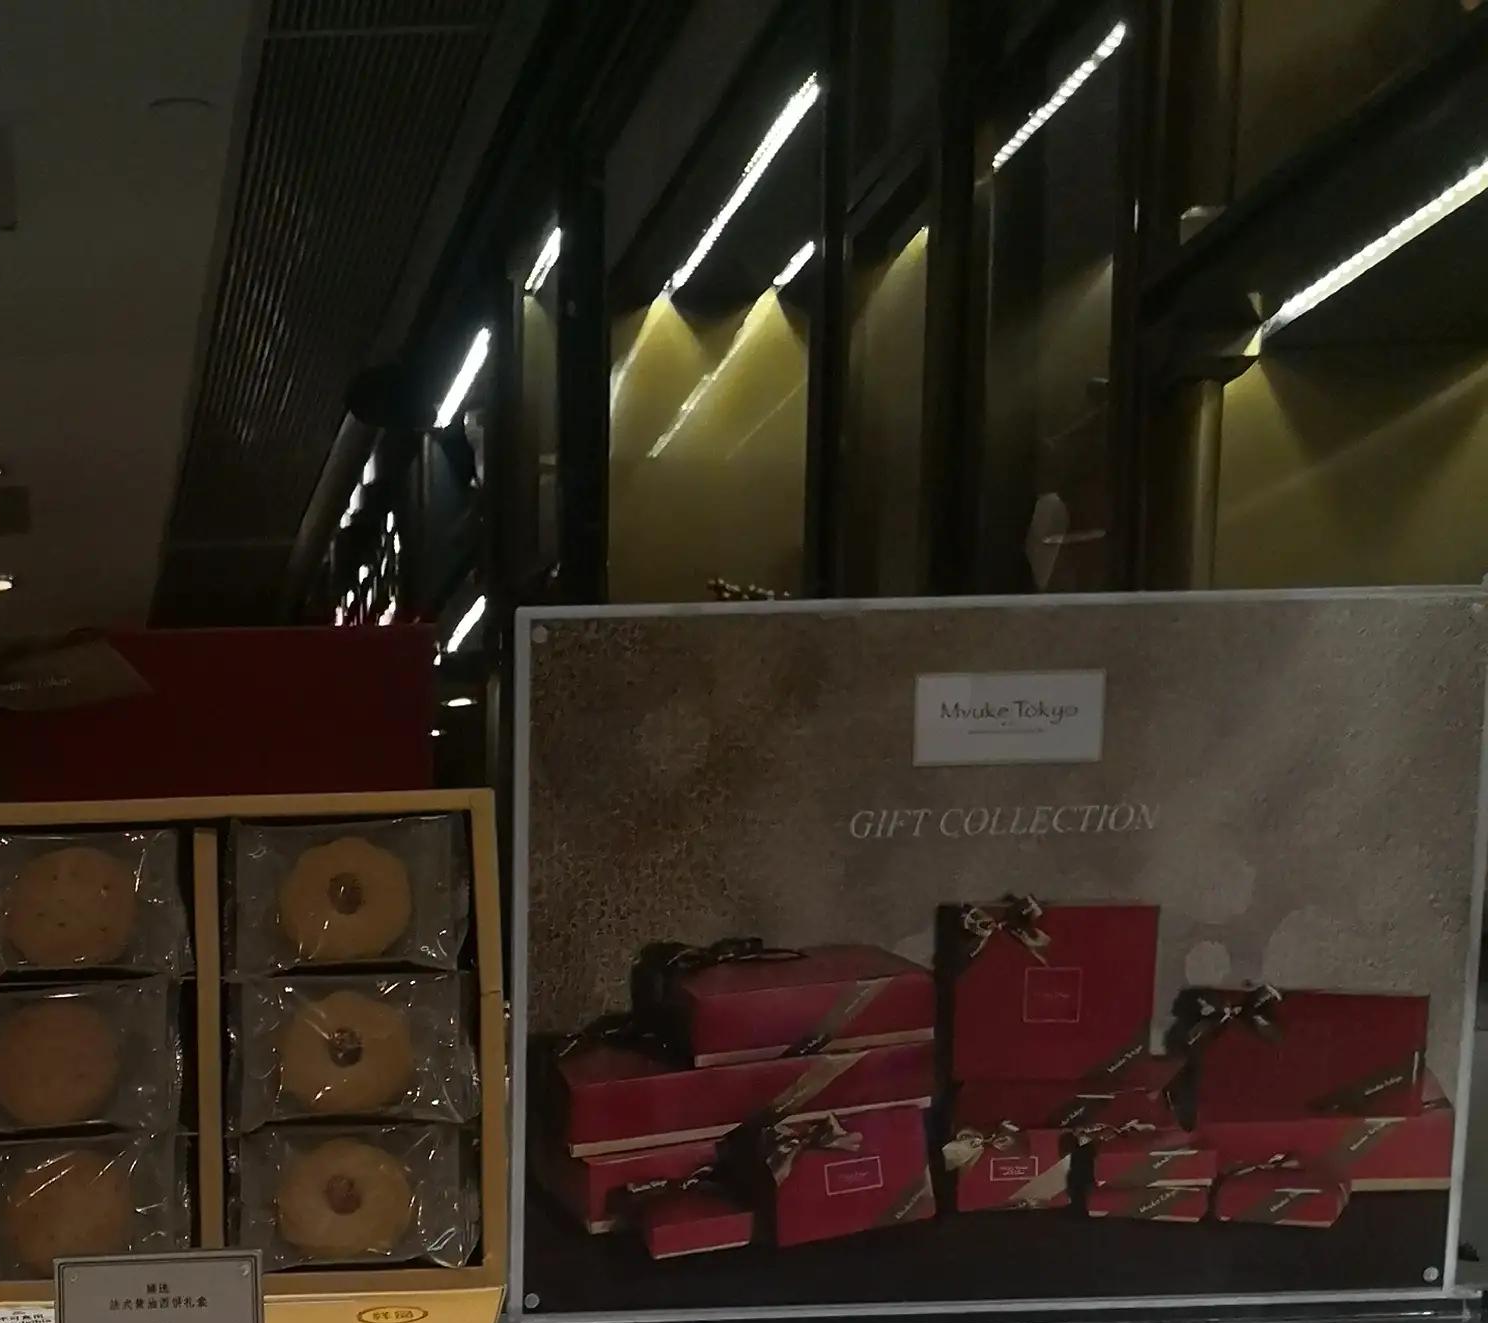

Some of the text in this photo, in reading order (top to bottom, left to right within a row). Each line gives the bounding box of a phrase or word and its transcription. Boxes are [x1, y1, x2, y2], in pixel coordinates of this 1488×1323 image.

[1011, 700, 1079, 725] Tokyo
[848, 802, 1162, 842] GIFT COLLECTION
